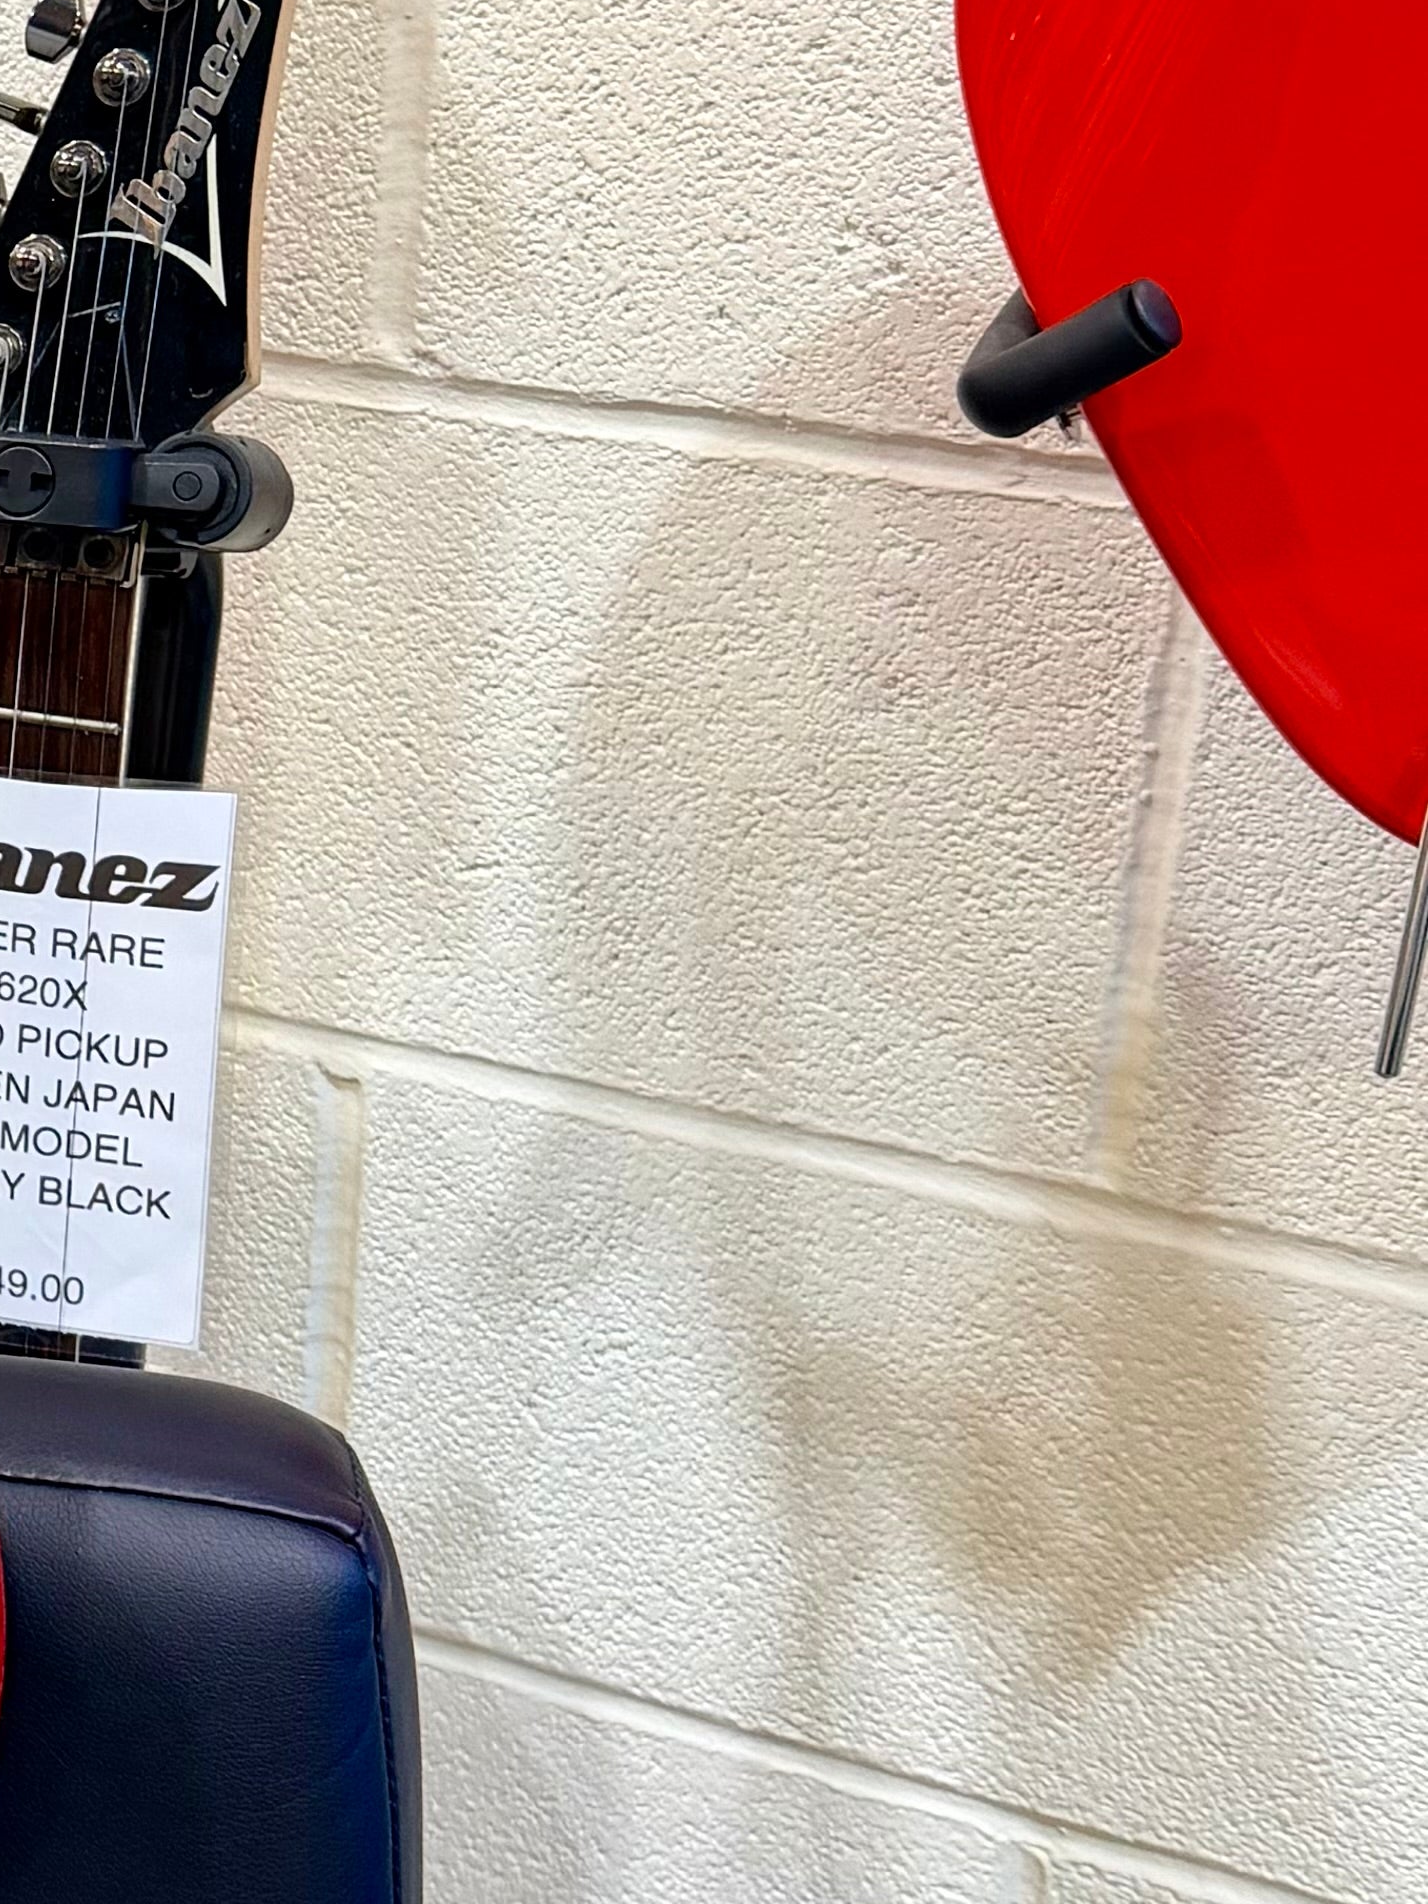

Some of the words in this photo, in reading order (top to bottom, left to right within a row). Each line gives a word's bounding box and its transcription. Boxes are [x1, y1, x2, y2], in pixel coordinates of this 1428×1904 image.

[49, 932, 167, 970] RARE
[17, 1026, 170, 1070] PICKUP
[43, 1080, 176, 1122] JAPAN
[0, 1121, 144, 1167] MODEL
[37, 1175, 172, 1220] BLACK
